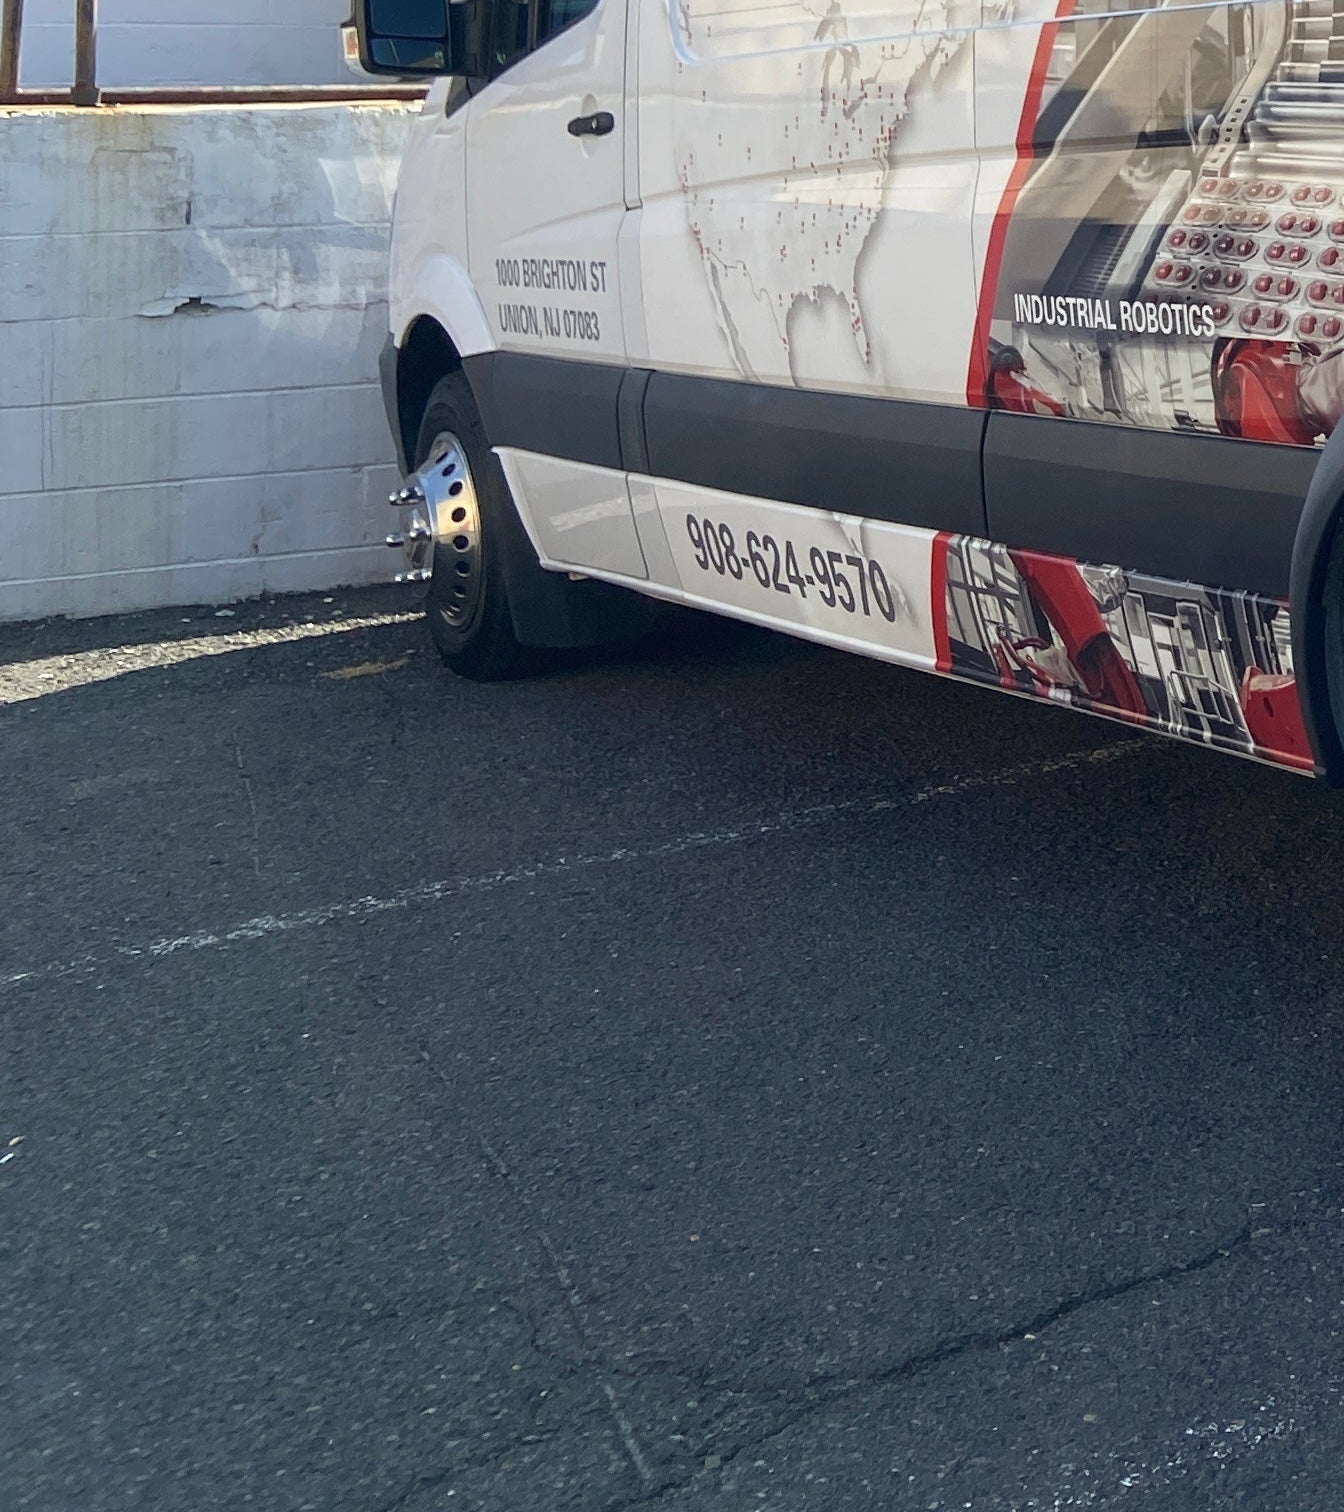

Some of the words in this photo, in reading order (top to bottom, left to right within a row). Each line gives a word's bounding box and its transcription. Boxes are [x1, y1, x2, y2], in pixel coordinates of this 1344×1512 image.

[495, 258, 520, 287] 1000
[522, 258, 588, 291] BRIGHTON
[590, 261, 607, 293] ST
[498, 303, 543, 339] UNION,
[543, 306, 561, 337] NJ
[563, 310, 600, 341] 07083
[1013, 293, 1118, 332] INDUSTRIAL
[1119, 298, 1216, 337] ROBOTICS
[686, 513, 897, 623] 908-624-9570
